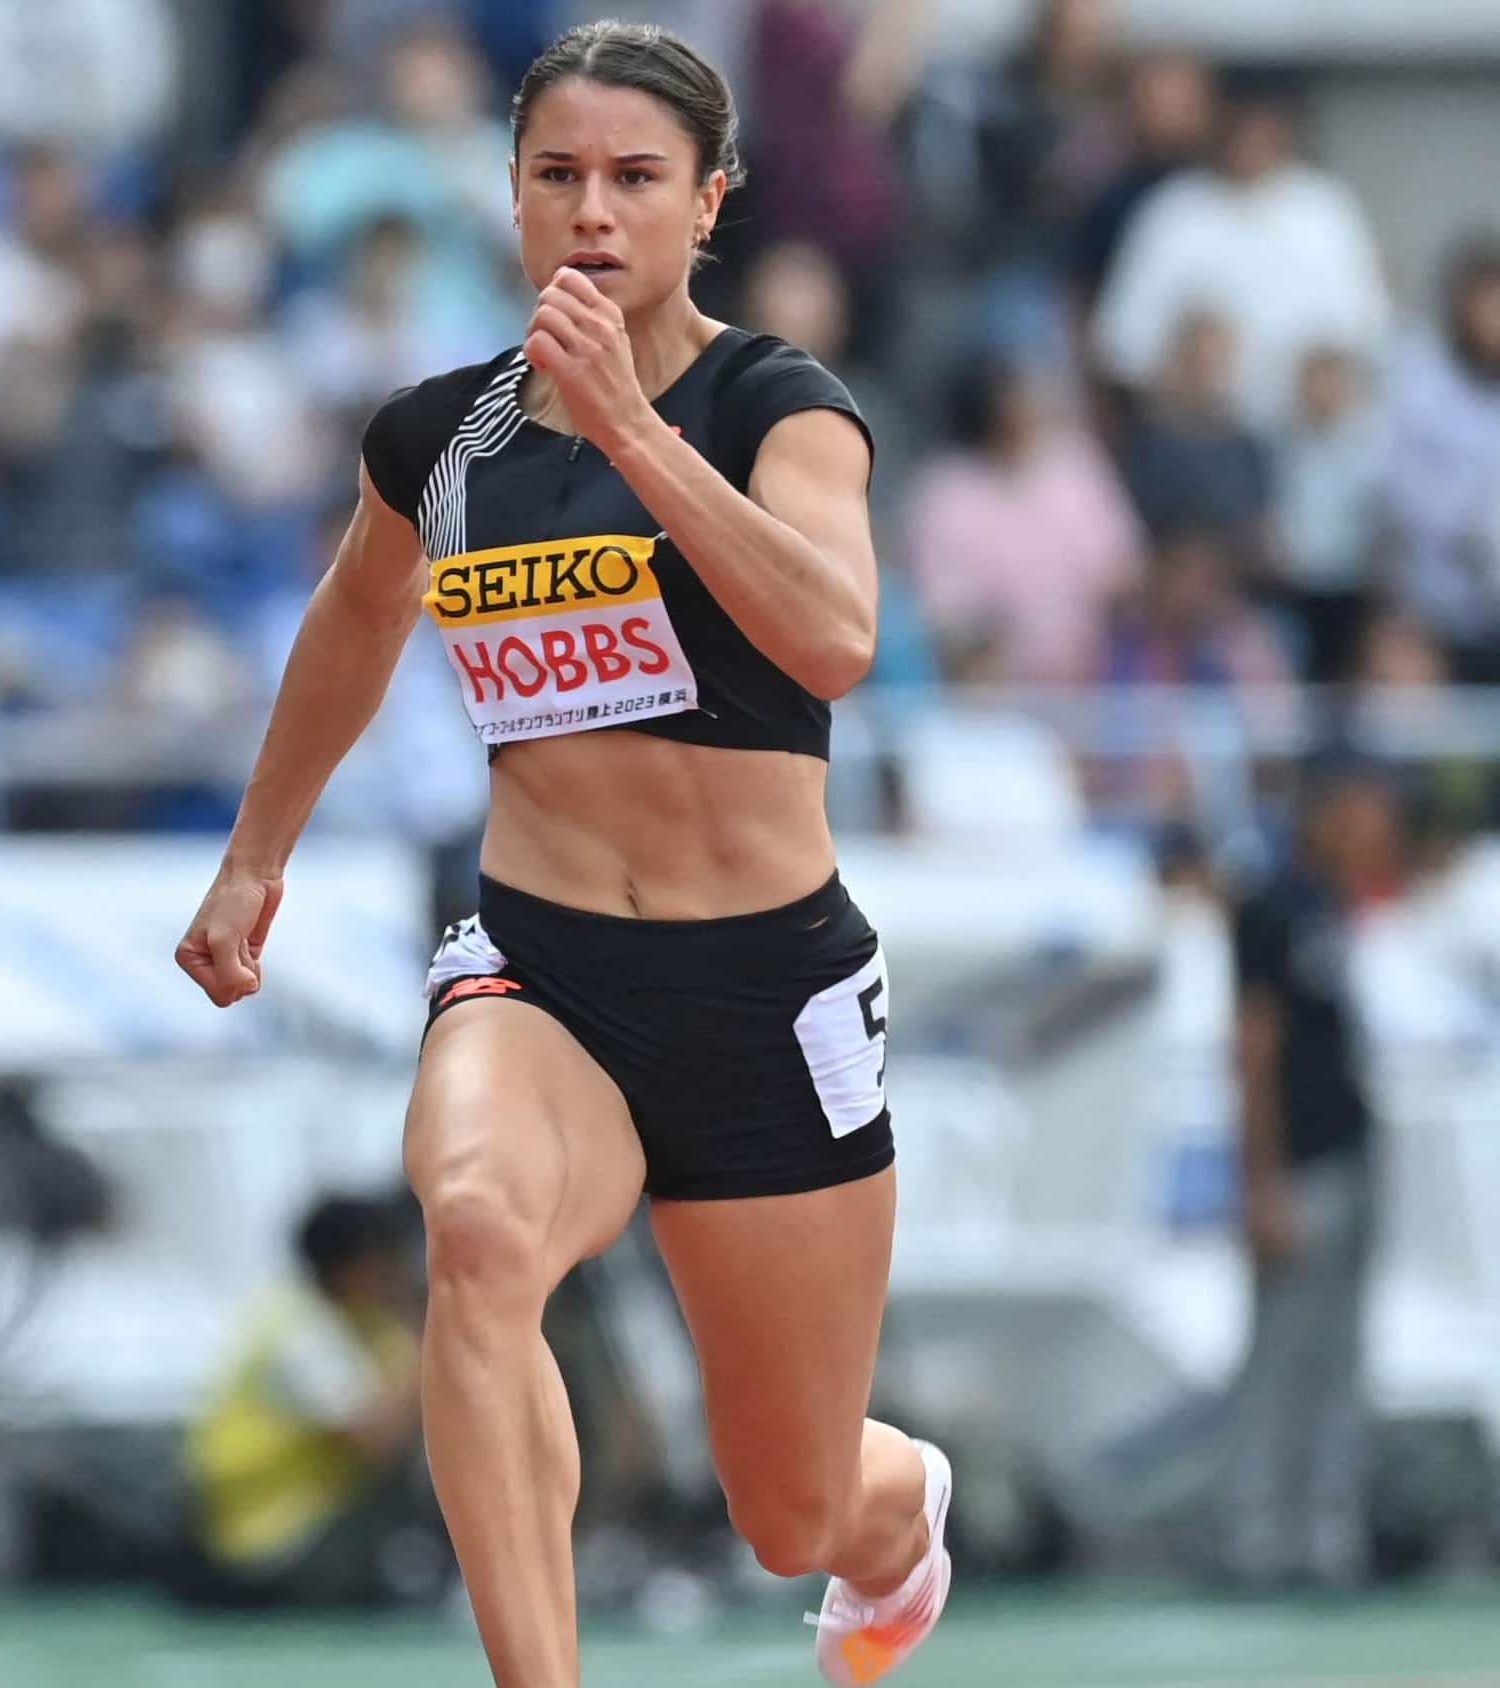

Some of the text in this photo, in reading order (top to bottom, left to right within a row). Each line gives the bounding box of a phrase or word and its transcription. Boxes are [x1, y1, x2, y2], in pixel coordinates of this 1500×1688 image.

[434, 545, 639, 618] SEIKO
[453, 617, 670, 703] HOBBS
[856, 975, 887, 1088] 5
